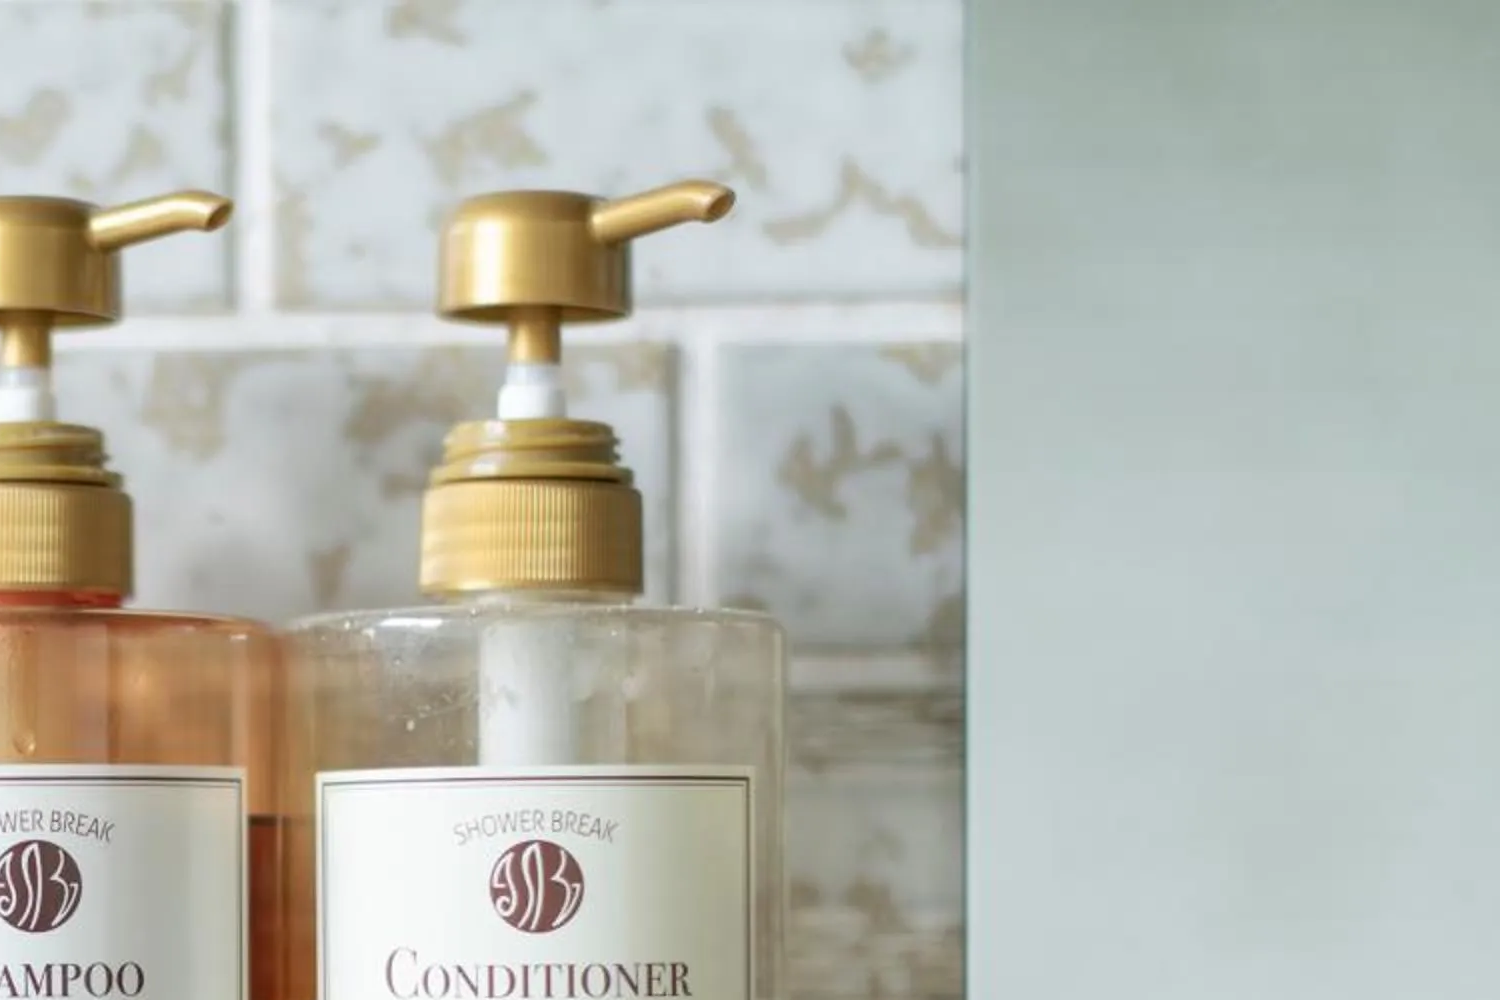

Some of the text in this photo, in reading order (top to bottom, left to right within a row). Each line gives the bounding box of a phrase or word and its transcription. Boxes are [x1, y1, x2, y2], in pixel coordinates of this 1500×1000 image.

[50, 811, 115, 843] BREAK
[453, 810, 620, 846] SHOWER BREAK
[385, 947, 693, 1000] CONDITIONER
